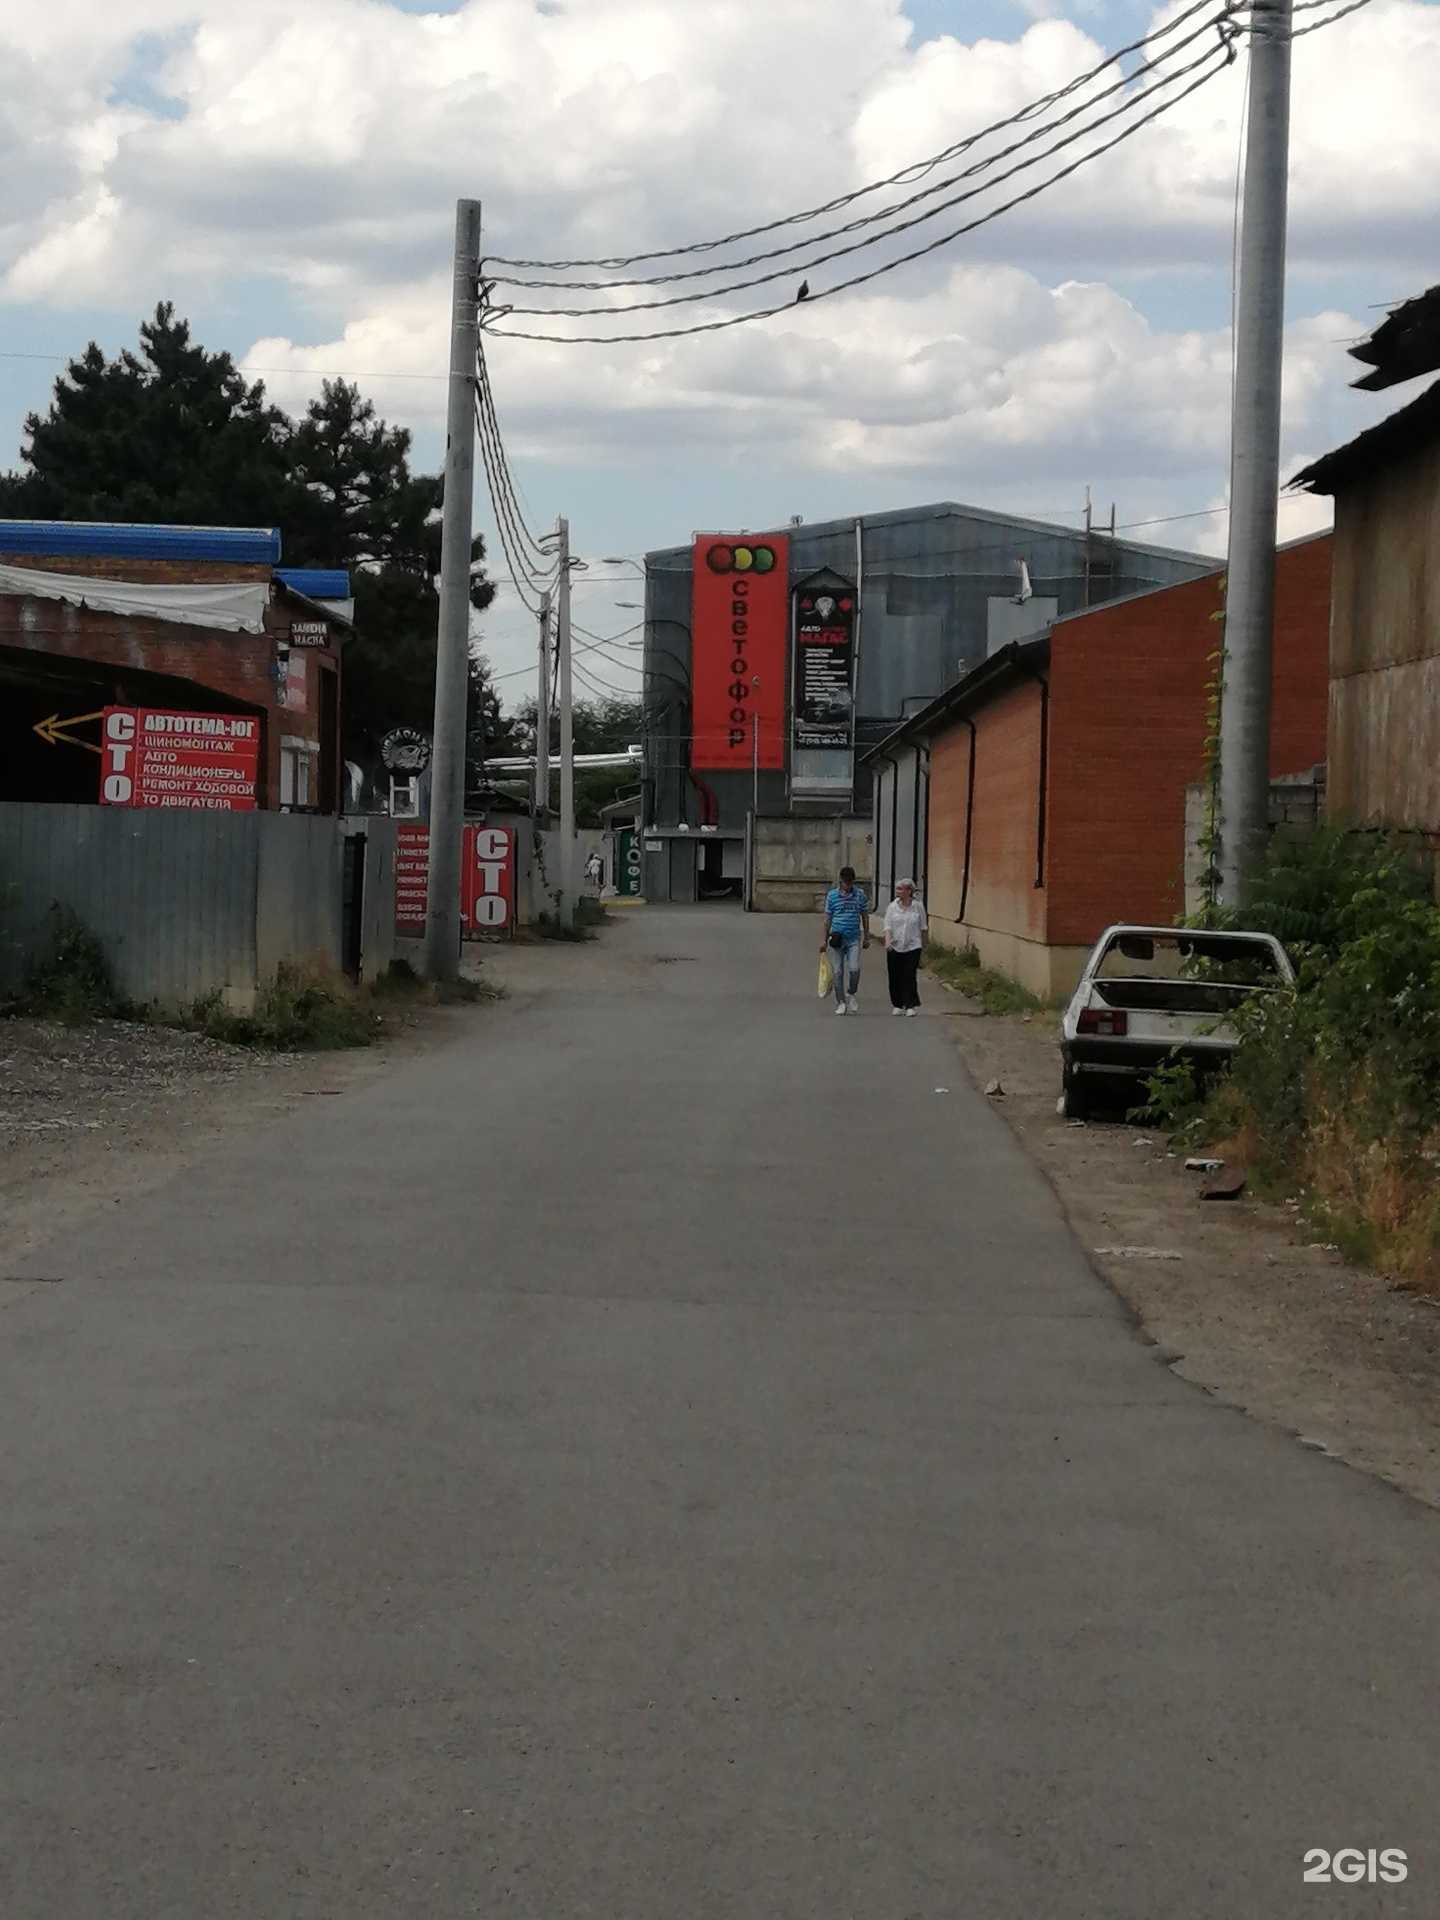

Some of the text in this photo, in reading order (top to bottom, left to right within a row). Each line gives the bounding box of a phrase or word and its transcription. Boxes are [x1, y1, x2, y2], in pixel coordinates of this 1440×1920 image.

[144, 715, 255, 737] АВТОТЕМА-ЮГ
[144, 736, 234, 752] ШИНОМОНТАЖ
[104, 712, 135, 802] СТО
[143, 751, 177, 763] АВТО
[142, 778, 254, 795] РЕМОНТ ХОДОВОЙ
[142, 793, 232, 809] ТО ДВИГАТЕЛЯ
[476, 828, 508, 926] СТО
